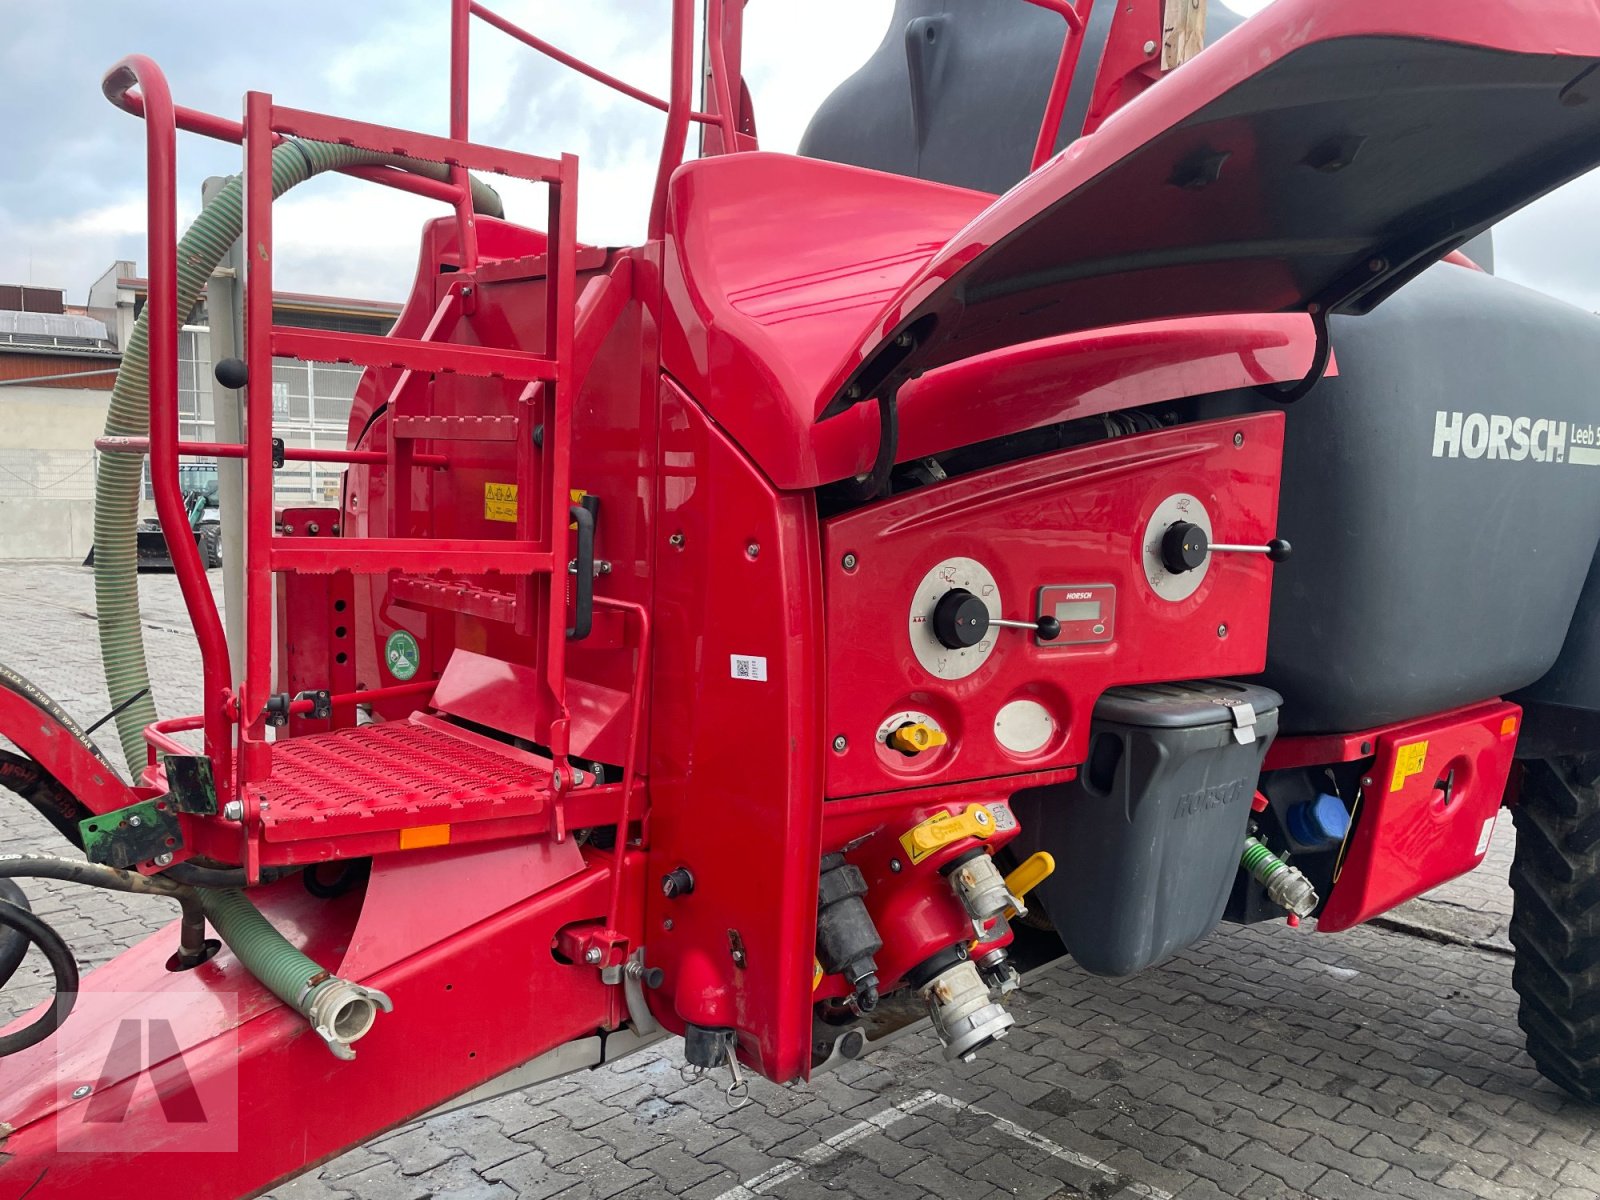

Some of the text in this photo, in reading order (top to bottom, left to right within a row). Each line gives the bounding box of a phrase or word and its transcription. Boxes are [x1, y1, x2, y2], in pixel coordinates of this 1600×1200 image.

[1432, 411, 1567, 462] HORSCH
[1571, 423, 1594, 445] Leeb
[1066, 592, 1092, 600] HORSCH
[80, 736, 92, 749] BAR
[1173, 777, 1248, 819] HORSCH
